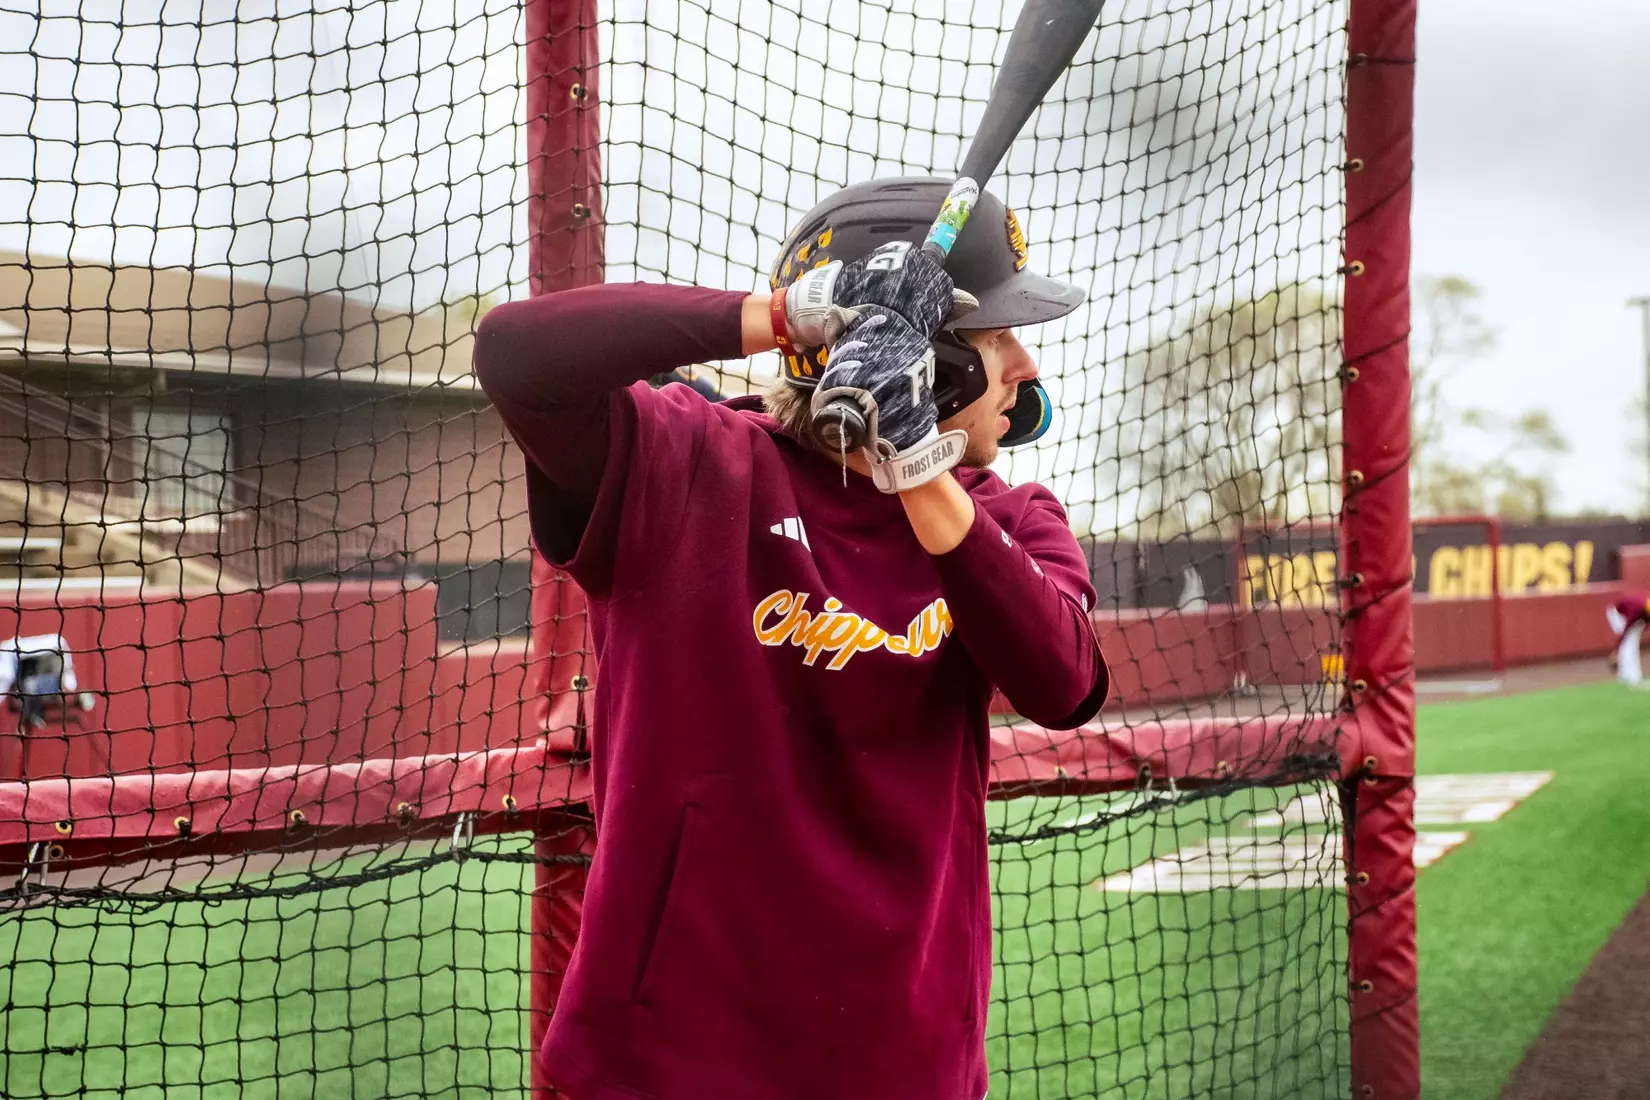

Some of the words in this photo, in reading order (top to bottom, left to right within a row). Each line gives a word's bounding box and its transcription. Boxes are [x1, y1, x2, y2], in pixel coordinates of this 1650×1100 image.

[902, 453, 931, 480] FROST
[931, 441, 955, 466] GEAR
[1244, 552, 1339, 609] FIRE
[1428, 540, 1595, 600] CHIPS!
